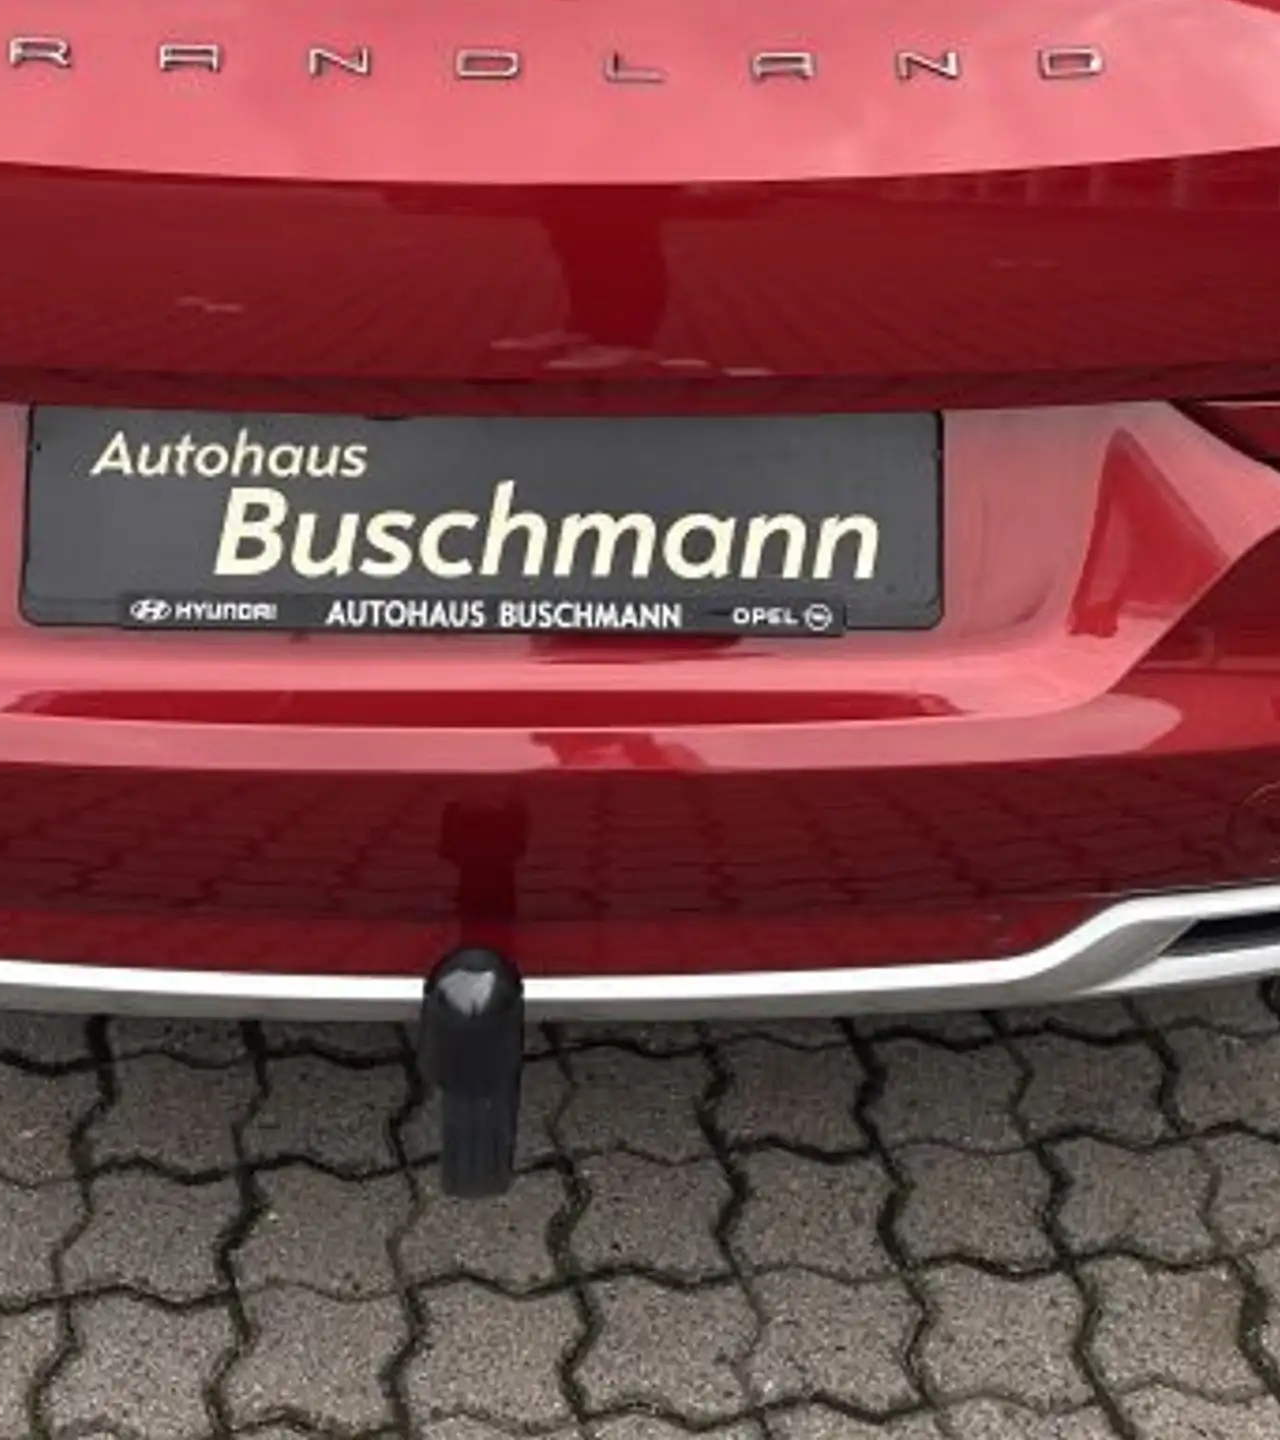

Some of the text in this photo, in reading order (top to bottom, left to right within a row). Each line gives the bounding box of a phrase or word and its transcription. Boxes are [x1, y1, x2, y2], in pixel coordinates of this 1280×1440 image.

[90, 427, 369, 479] Autohaus
[213, 479, 879, 580] Buschmann
[175, 602, 277, 621] HYUNDAI
[324, 600, 683, 630] AUTOHAUS BUSCHMANN
[732, 608, 800, 627] OPEL
